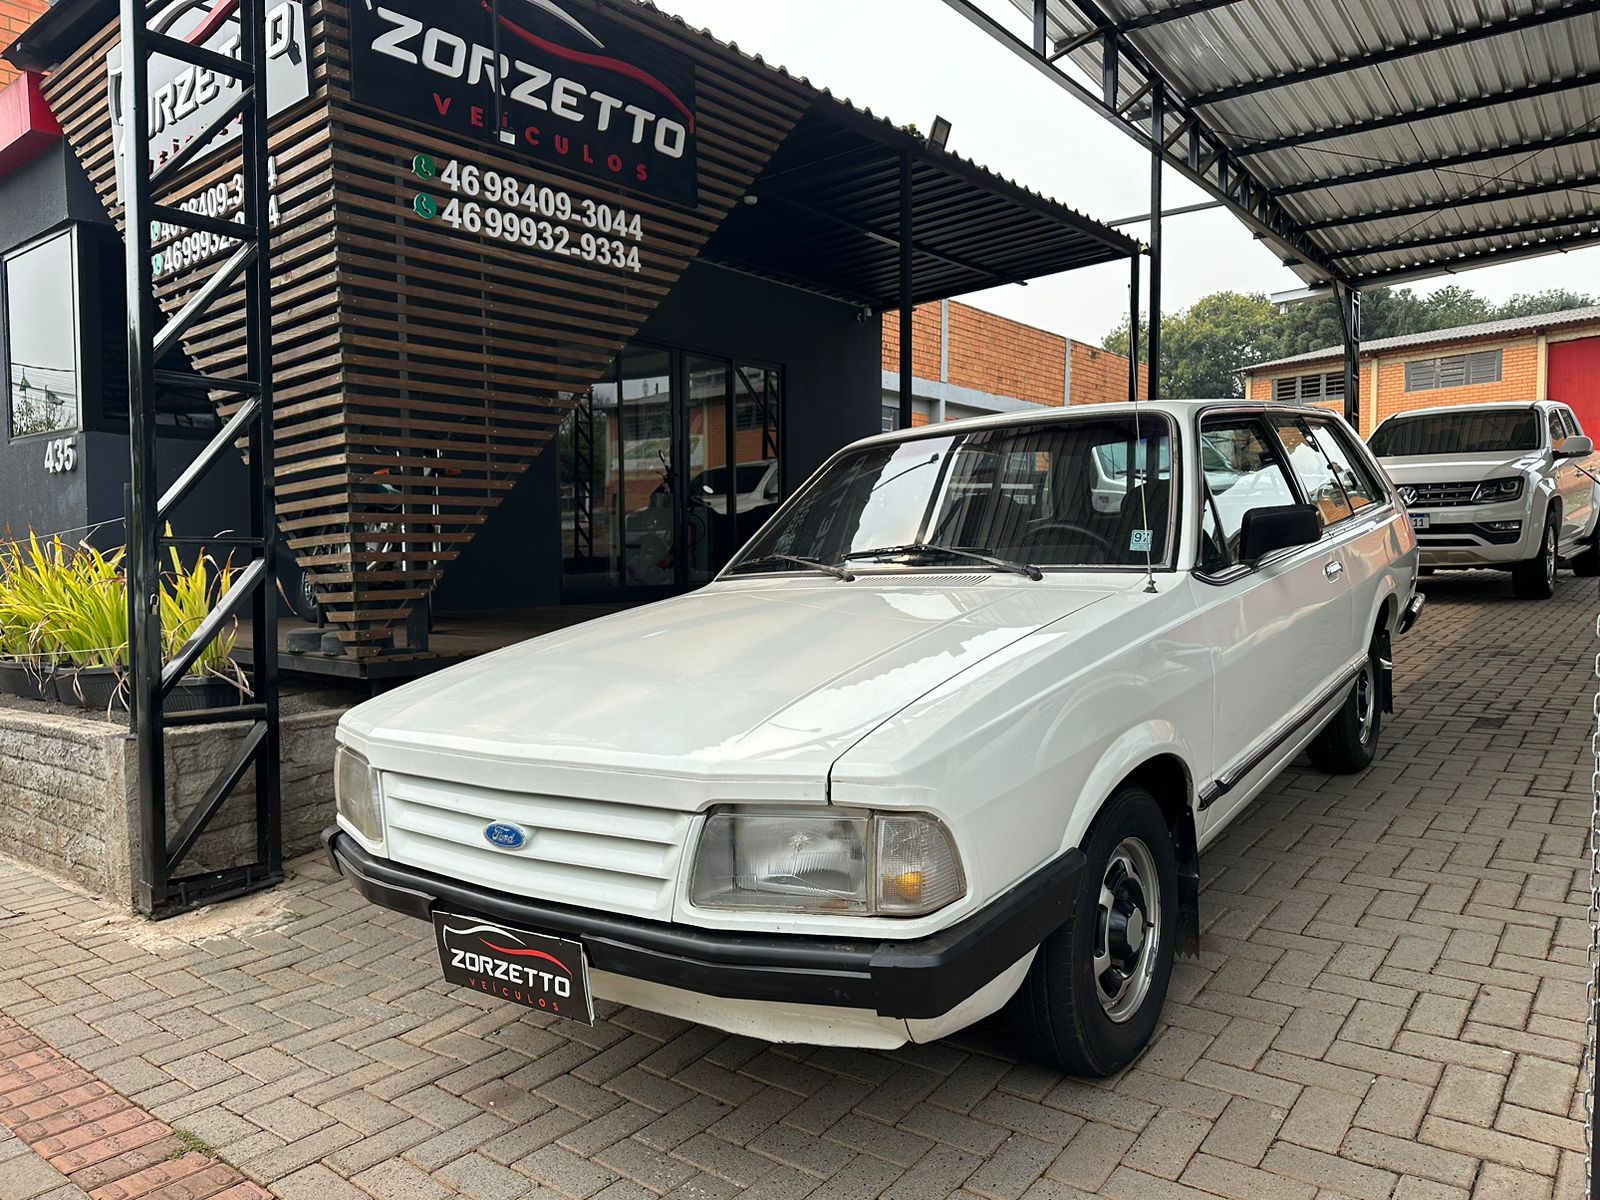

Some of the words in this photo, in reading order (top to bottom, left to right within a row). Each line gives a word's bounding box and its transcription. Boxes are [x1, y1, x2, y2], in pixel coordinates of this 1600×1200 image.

[371, 6, 686, 159] ZORZETTO
[432, 92, 648, 182] VEÍCULOS
[44, 436, 77, 474] 435
[1134, 532, 1151, 543] 97
[491, 825, 516, 844] Ford
[450, 947, 571, 998] ZORZETTO
[469, 977, 560, 1012] VEÍCULOS
